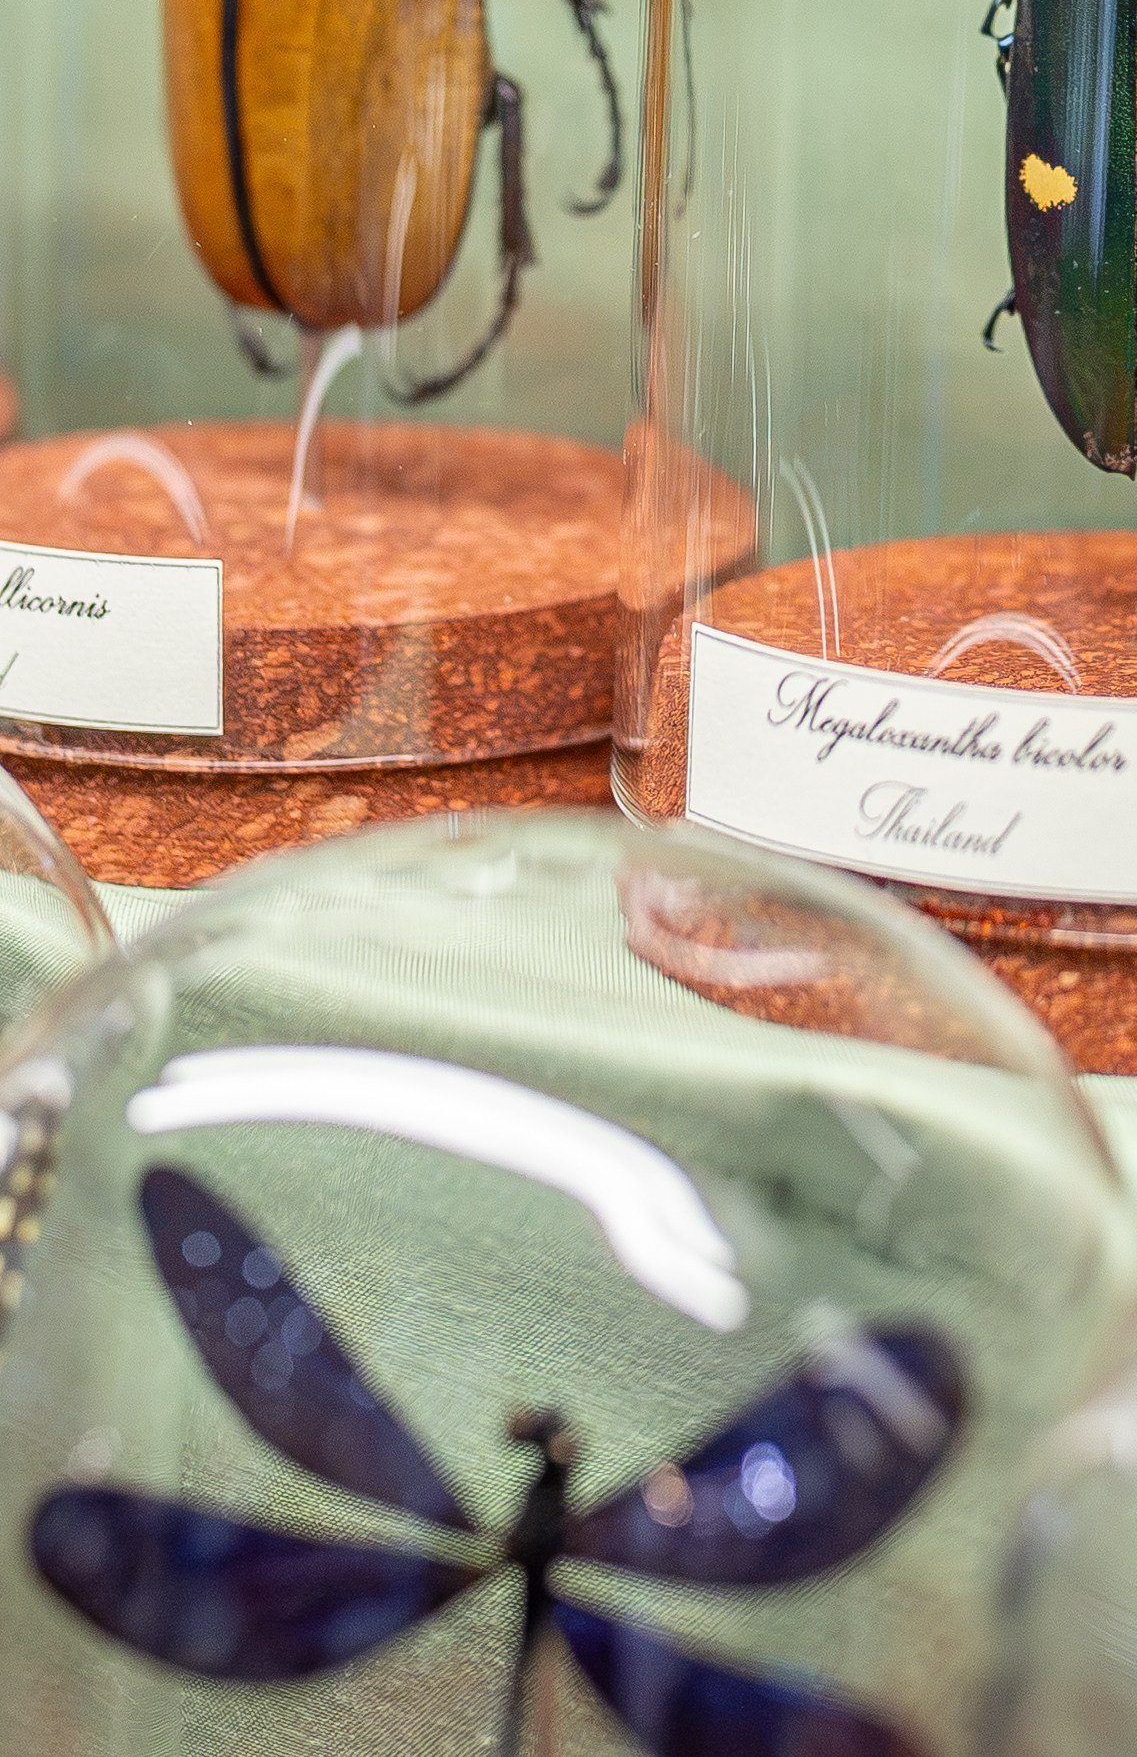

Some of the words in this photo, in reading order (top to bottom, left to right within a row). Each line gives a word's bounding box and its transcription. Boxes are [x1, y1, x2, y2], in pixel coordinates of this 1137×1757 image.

[767, 671, 1004, 761] Megaloxantha
[1011, 717, 1127, 771] bicolor
[854, 780, 1023, 855] Thailand
